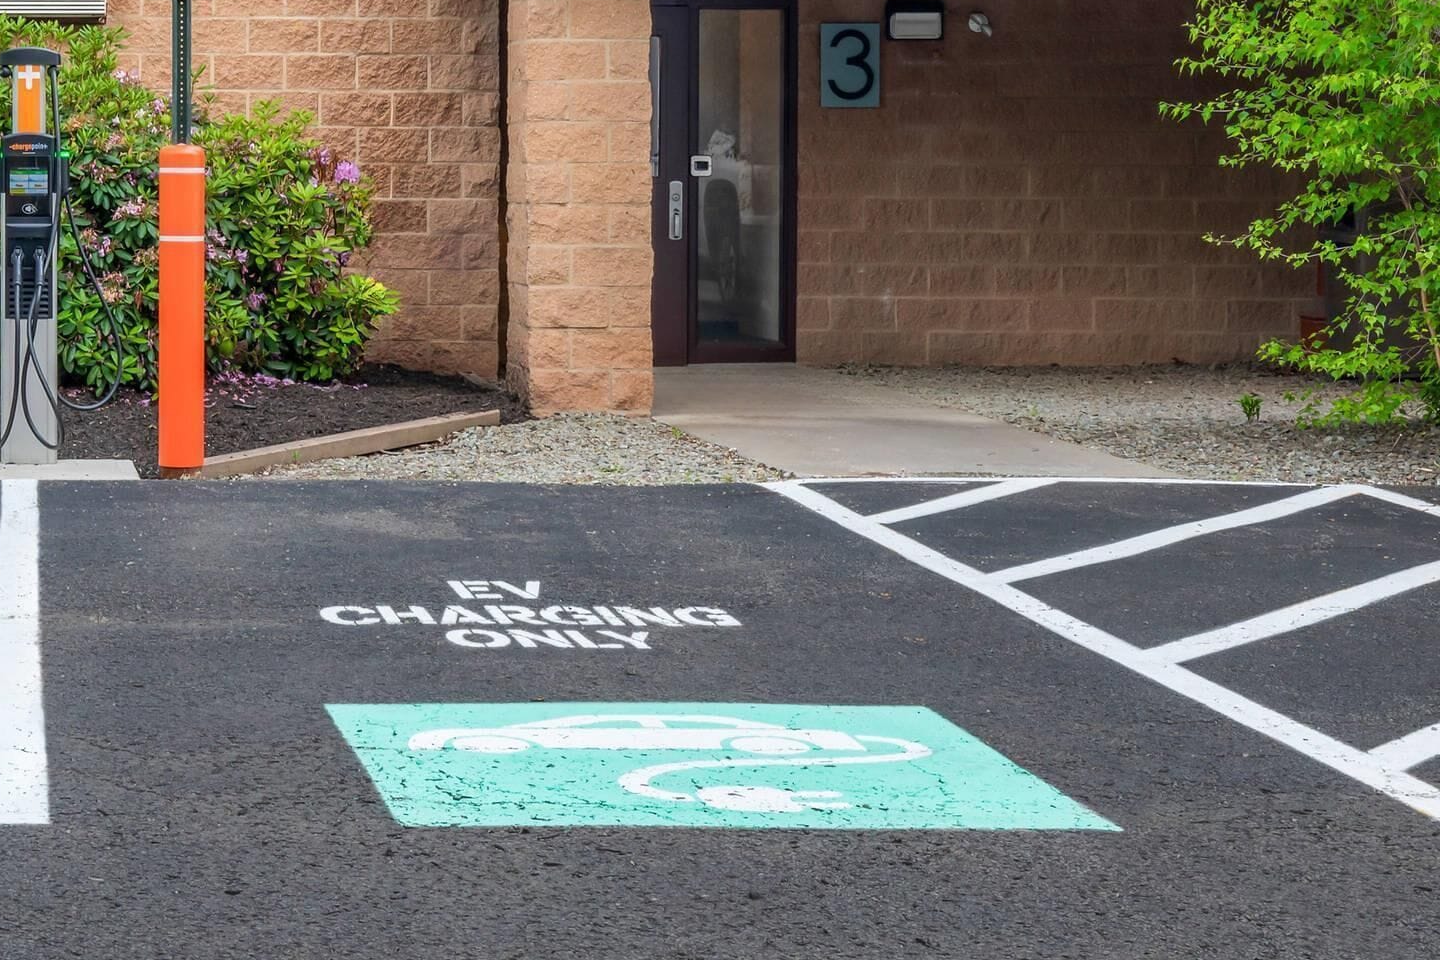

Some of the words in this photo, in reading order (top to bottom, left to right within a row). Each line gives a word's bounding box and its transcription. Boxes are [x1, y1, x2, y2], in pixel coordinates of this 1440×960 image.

[827, 28, 875, 101] 3
[446, 580, 541, 600] EV
[319, 604, 743, 628] CHARGING
[445, 628, 652, 650] ONLY
